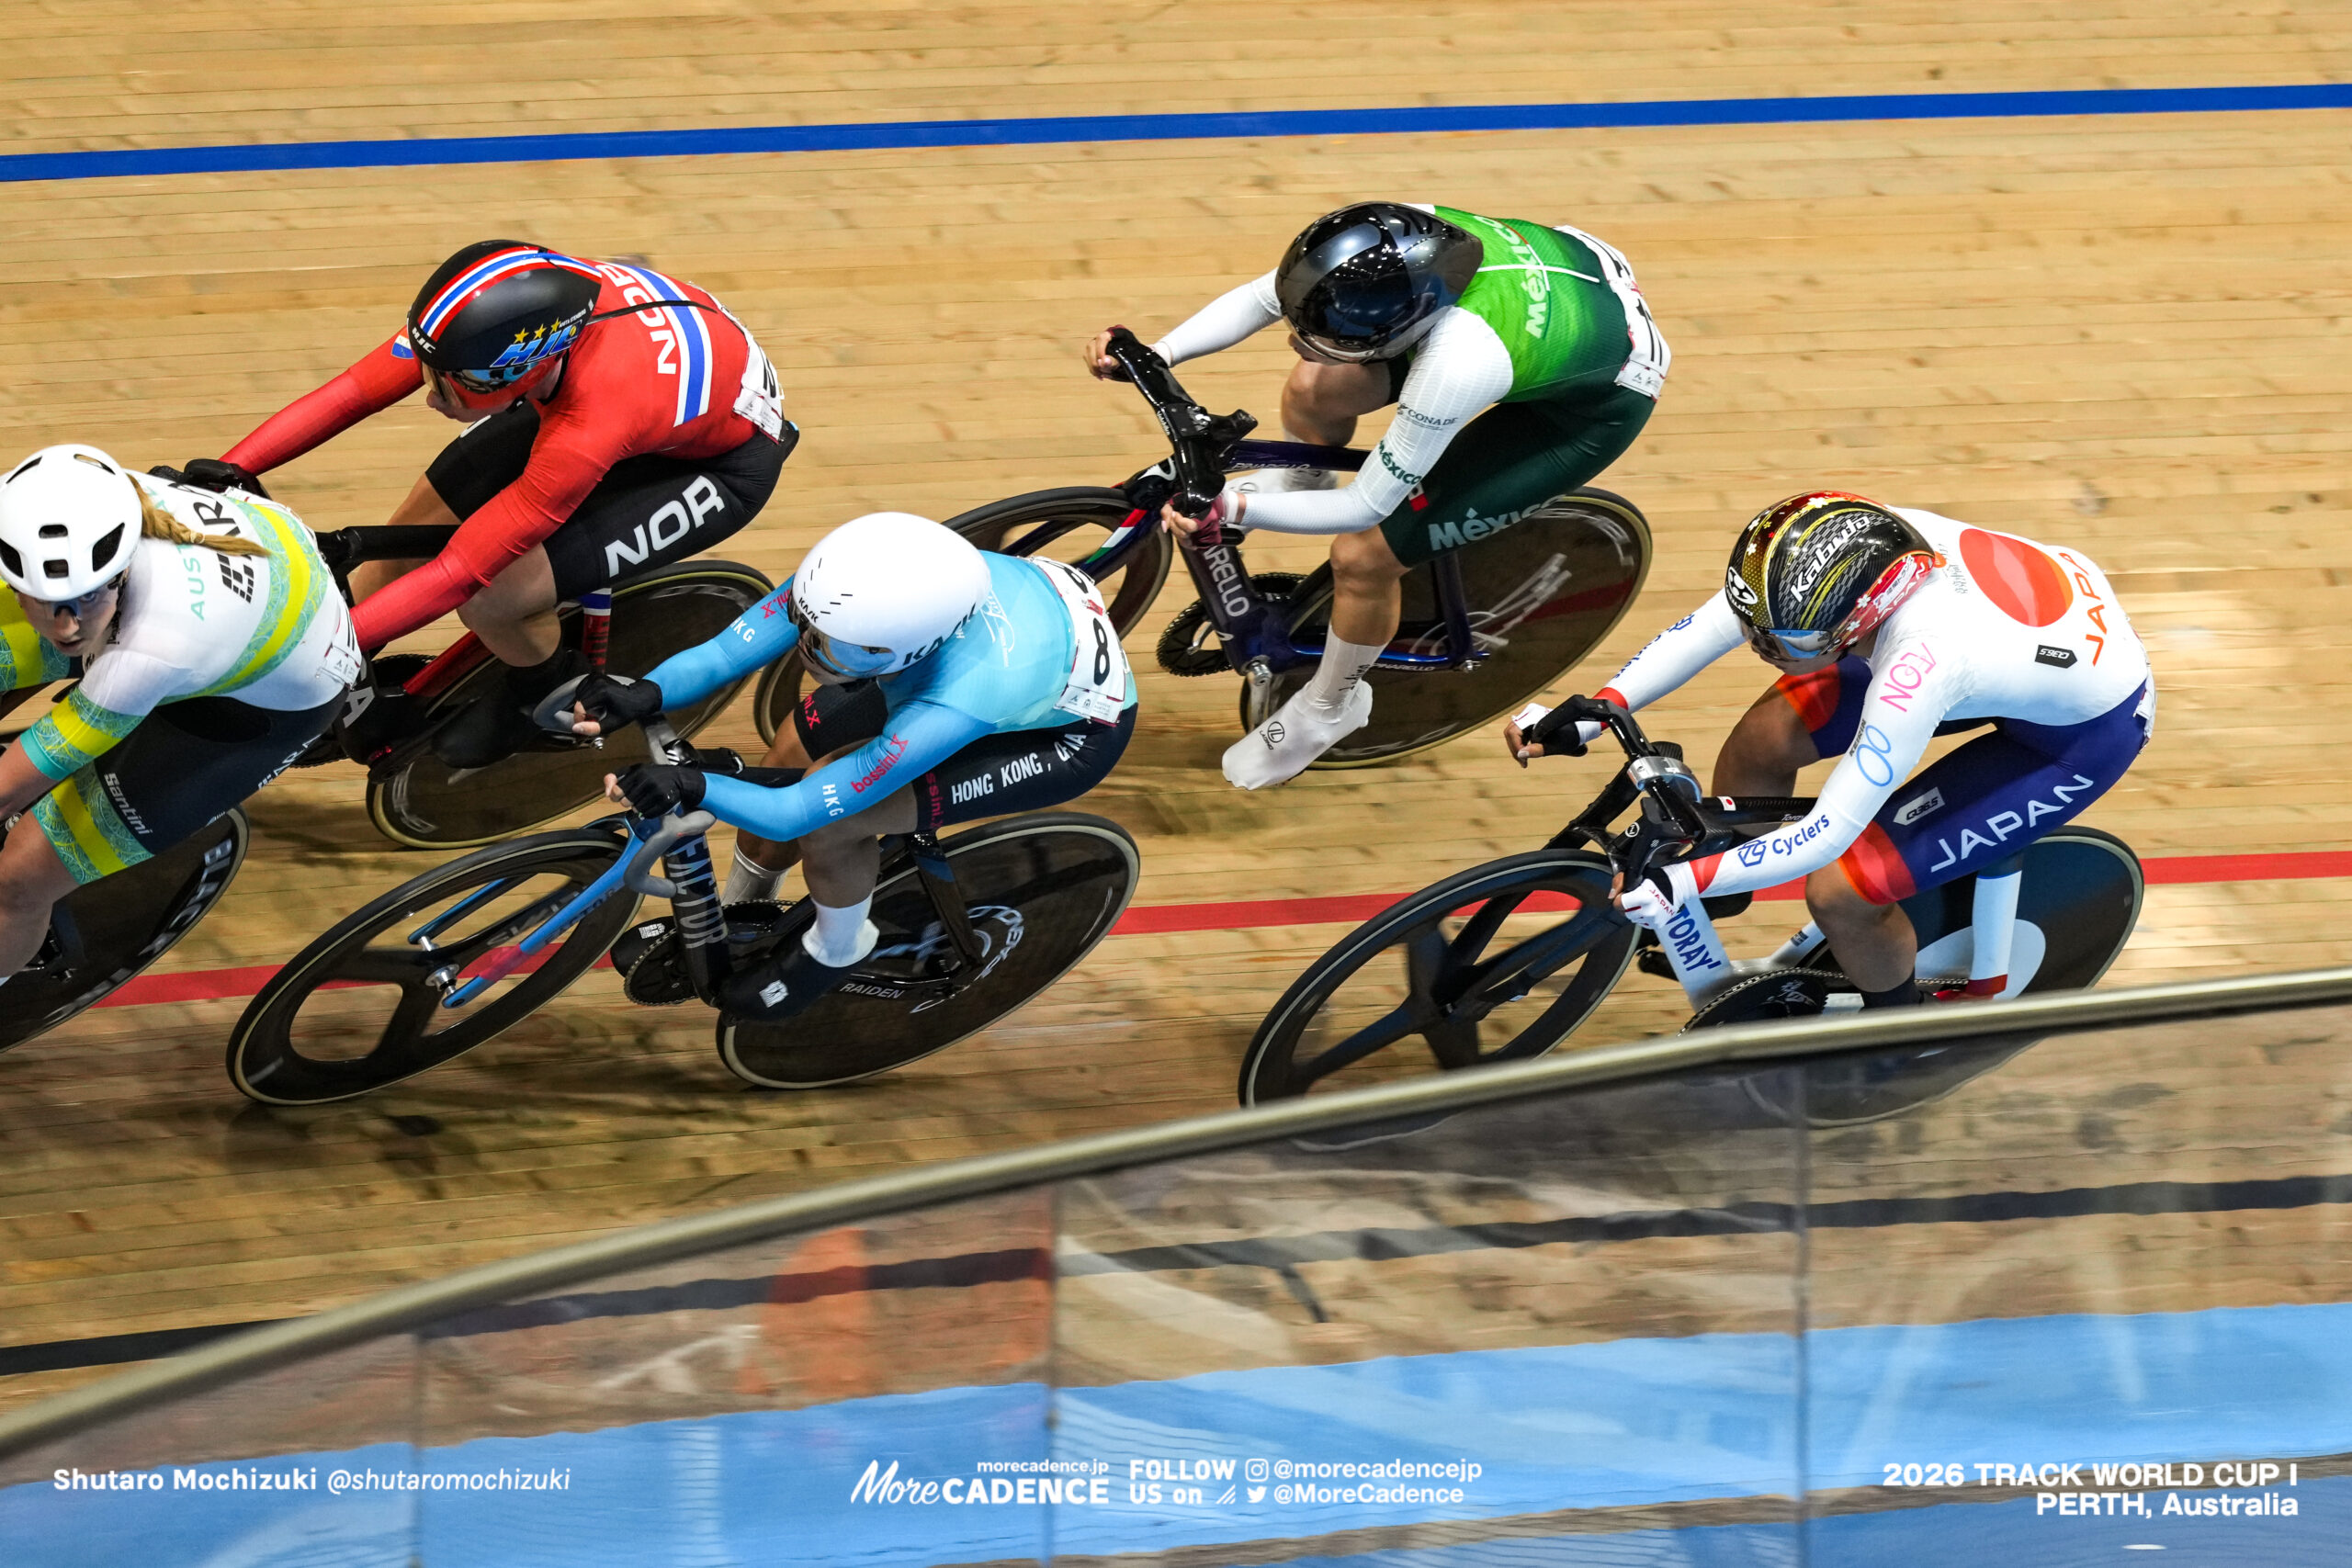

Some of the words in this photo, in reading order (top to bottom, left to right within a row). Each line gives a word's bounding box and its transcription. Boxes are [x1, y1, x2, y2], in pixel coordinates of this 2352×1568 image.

[1408, 408, 1459, 426] CONADE
[605, 475, 725, 578] NOR
[1791, 516, 1870, 602] Kabuto
[797, 596, 819, 624] KASK
[1092, 617, 1111, 686] 8
[822, 784, 844, 817] HKG
[951, 773, 994, 805] HONG
[1772, 813, 1830, 856] Cyclers
[1930, 773, 2095, 873] JAPAN
[839, 981, 906, 1000] RAIDEN
